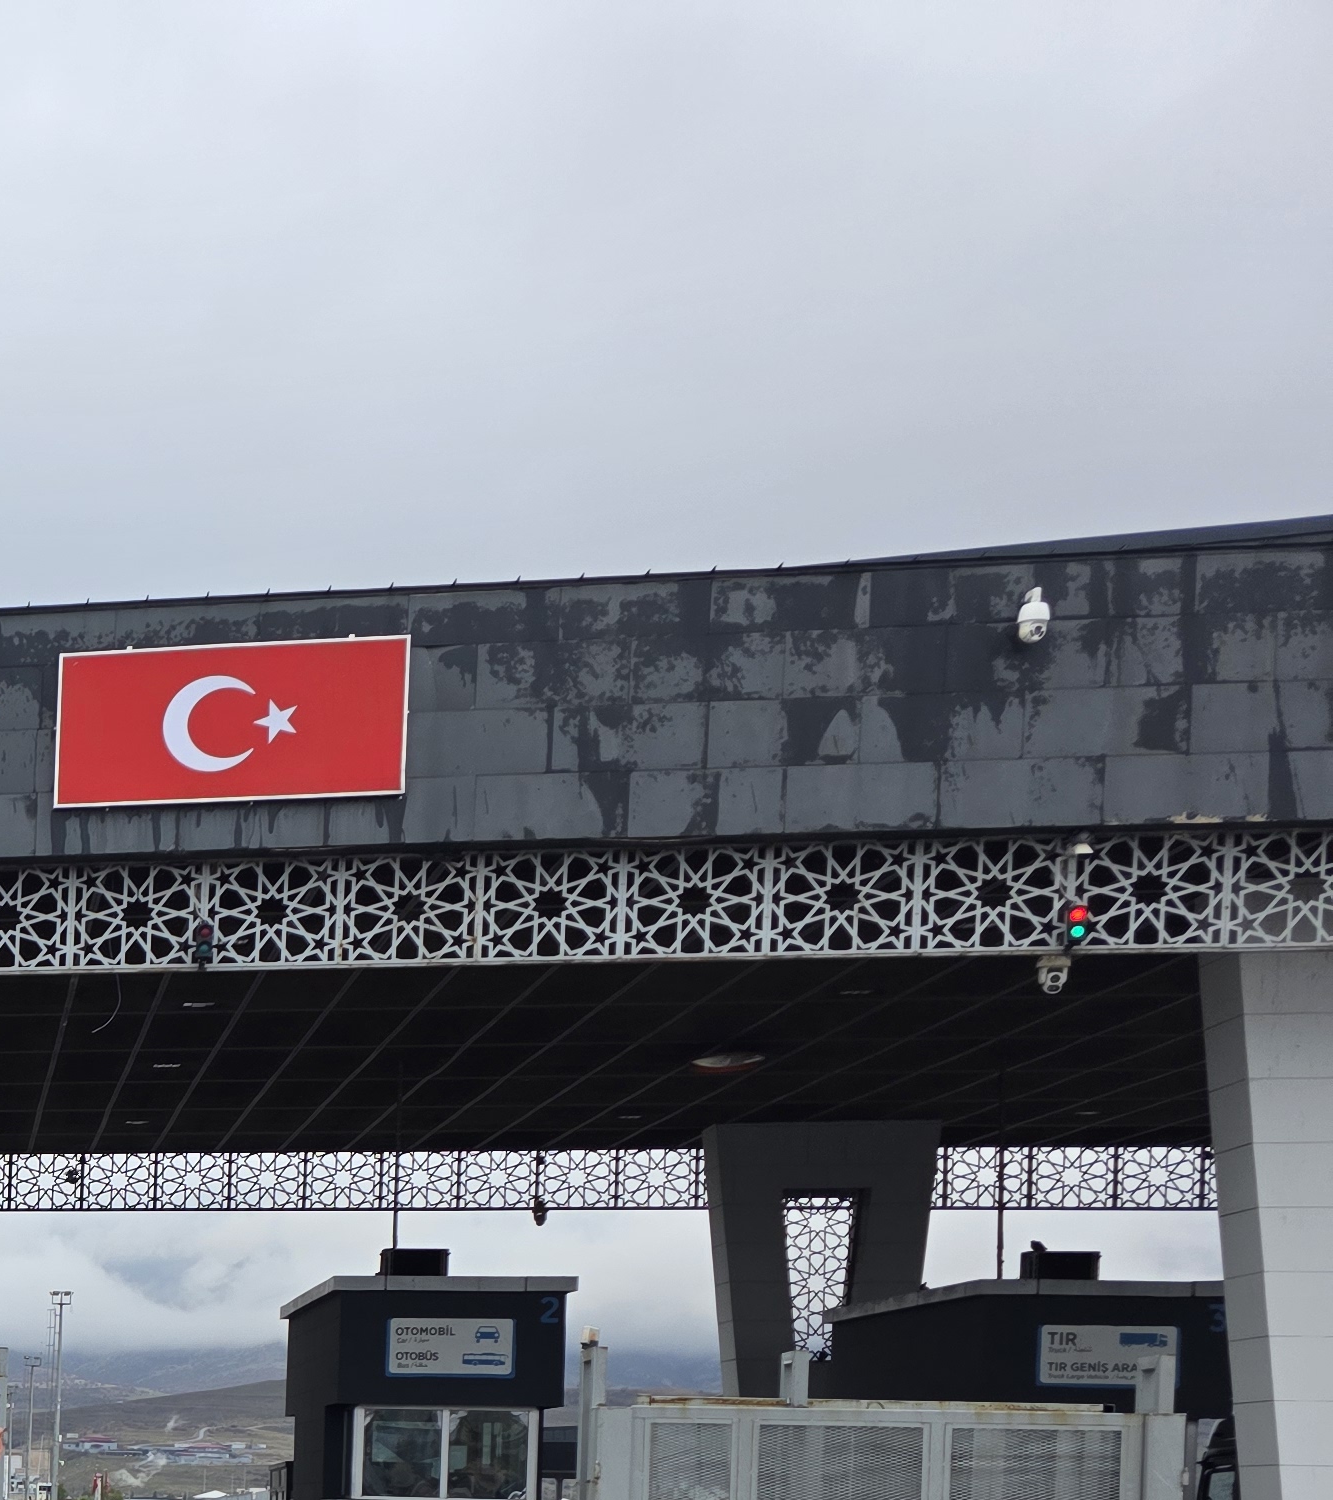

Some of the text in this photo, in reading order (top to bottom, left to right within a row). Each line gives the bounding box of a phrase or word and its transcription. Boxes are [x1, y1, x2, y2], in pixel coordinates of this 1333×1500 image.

[540, 1297, 560, 1323] 2
[395, 1324, 456, 1336] OTOMOBİL
[1047, 1331, 1077, 1346] TIR
[395, 1350, 439, 1361] OTOBÜS
[1047, 1361, 1138, 1373] TIR GENİŞ ARA
